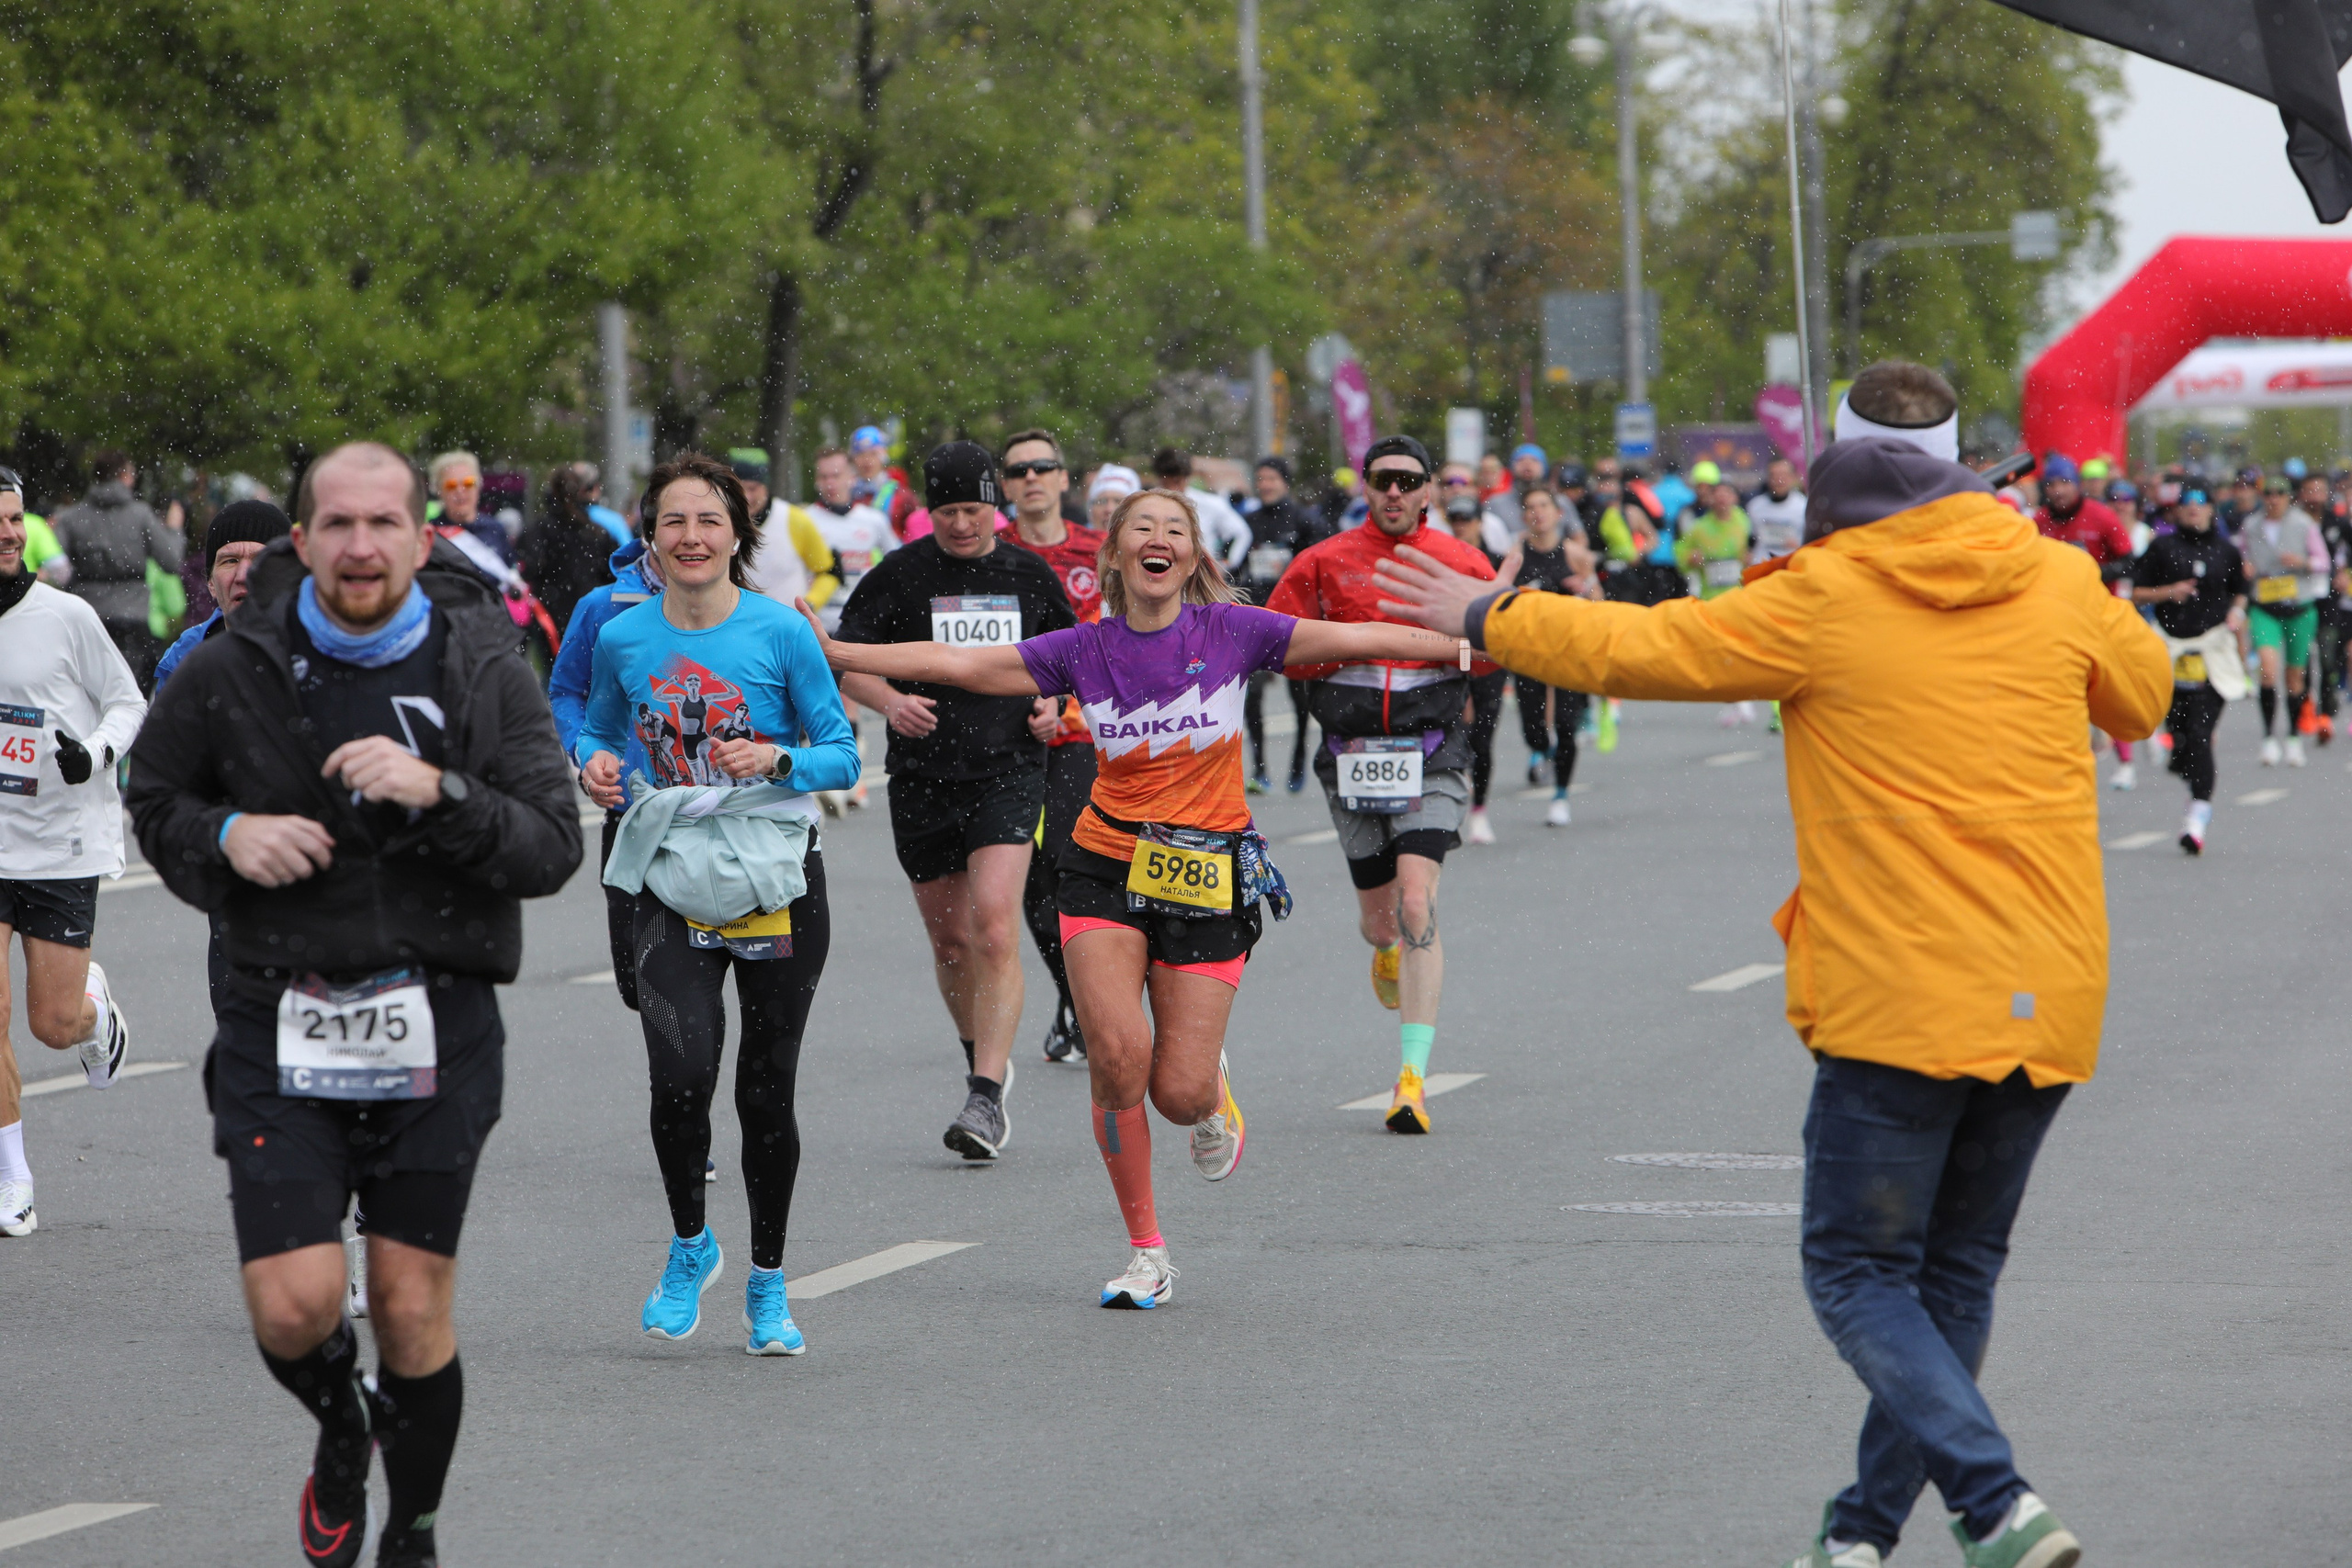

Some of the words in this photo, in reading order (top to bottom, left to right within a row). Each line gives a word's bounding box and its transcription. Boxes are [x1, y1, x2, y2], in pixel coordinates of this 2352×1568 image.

[939, 619, 1013, 642] 10401
[1099, 712, 1219, 739] BAIKAL
[1, 736, 36, 764] 45
[1351, 760, 1409, 782] 6886
[1147, 851, 1220, 890] 5988
[1135, 895, 1147, 908] B
[1160, 885, 1201, 899] НАТАЛЬЯ
[696, 931, 709, 945] C
[301, 1003, 408, 1042] 2175
[292, 1068, 313, 1090] C
